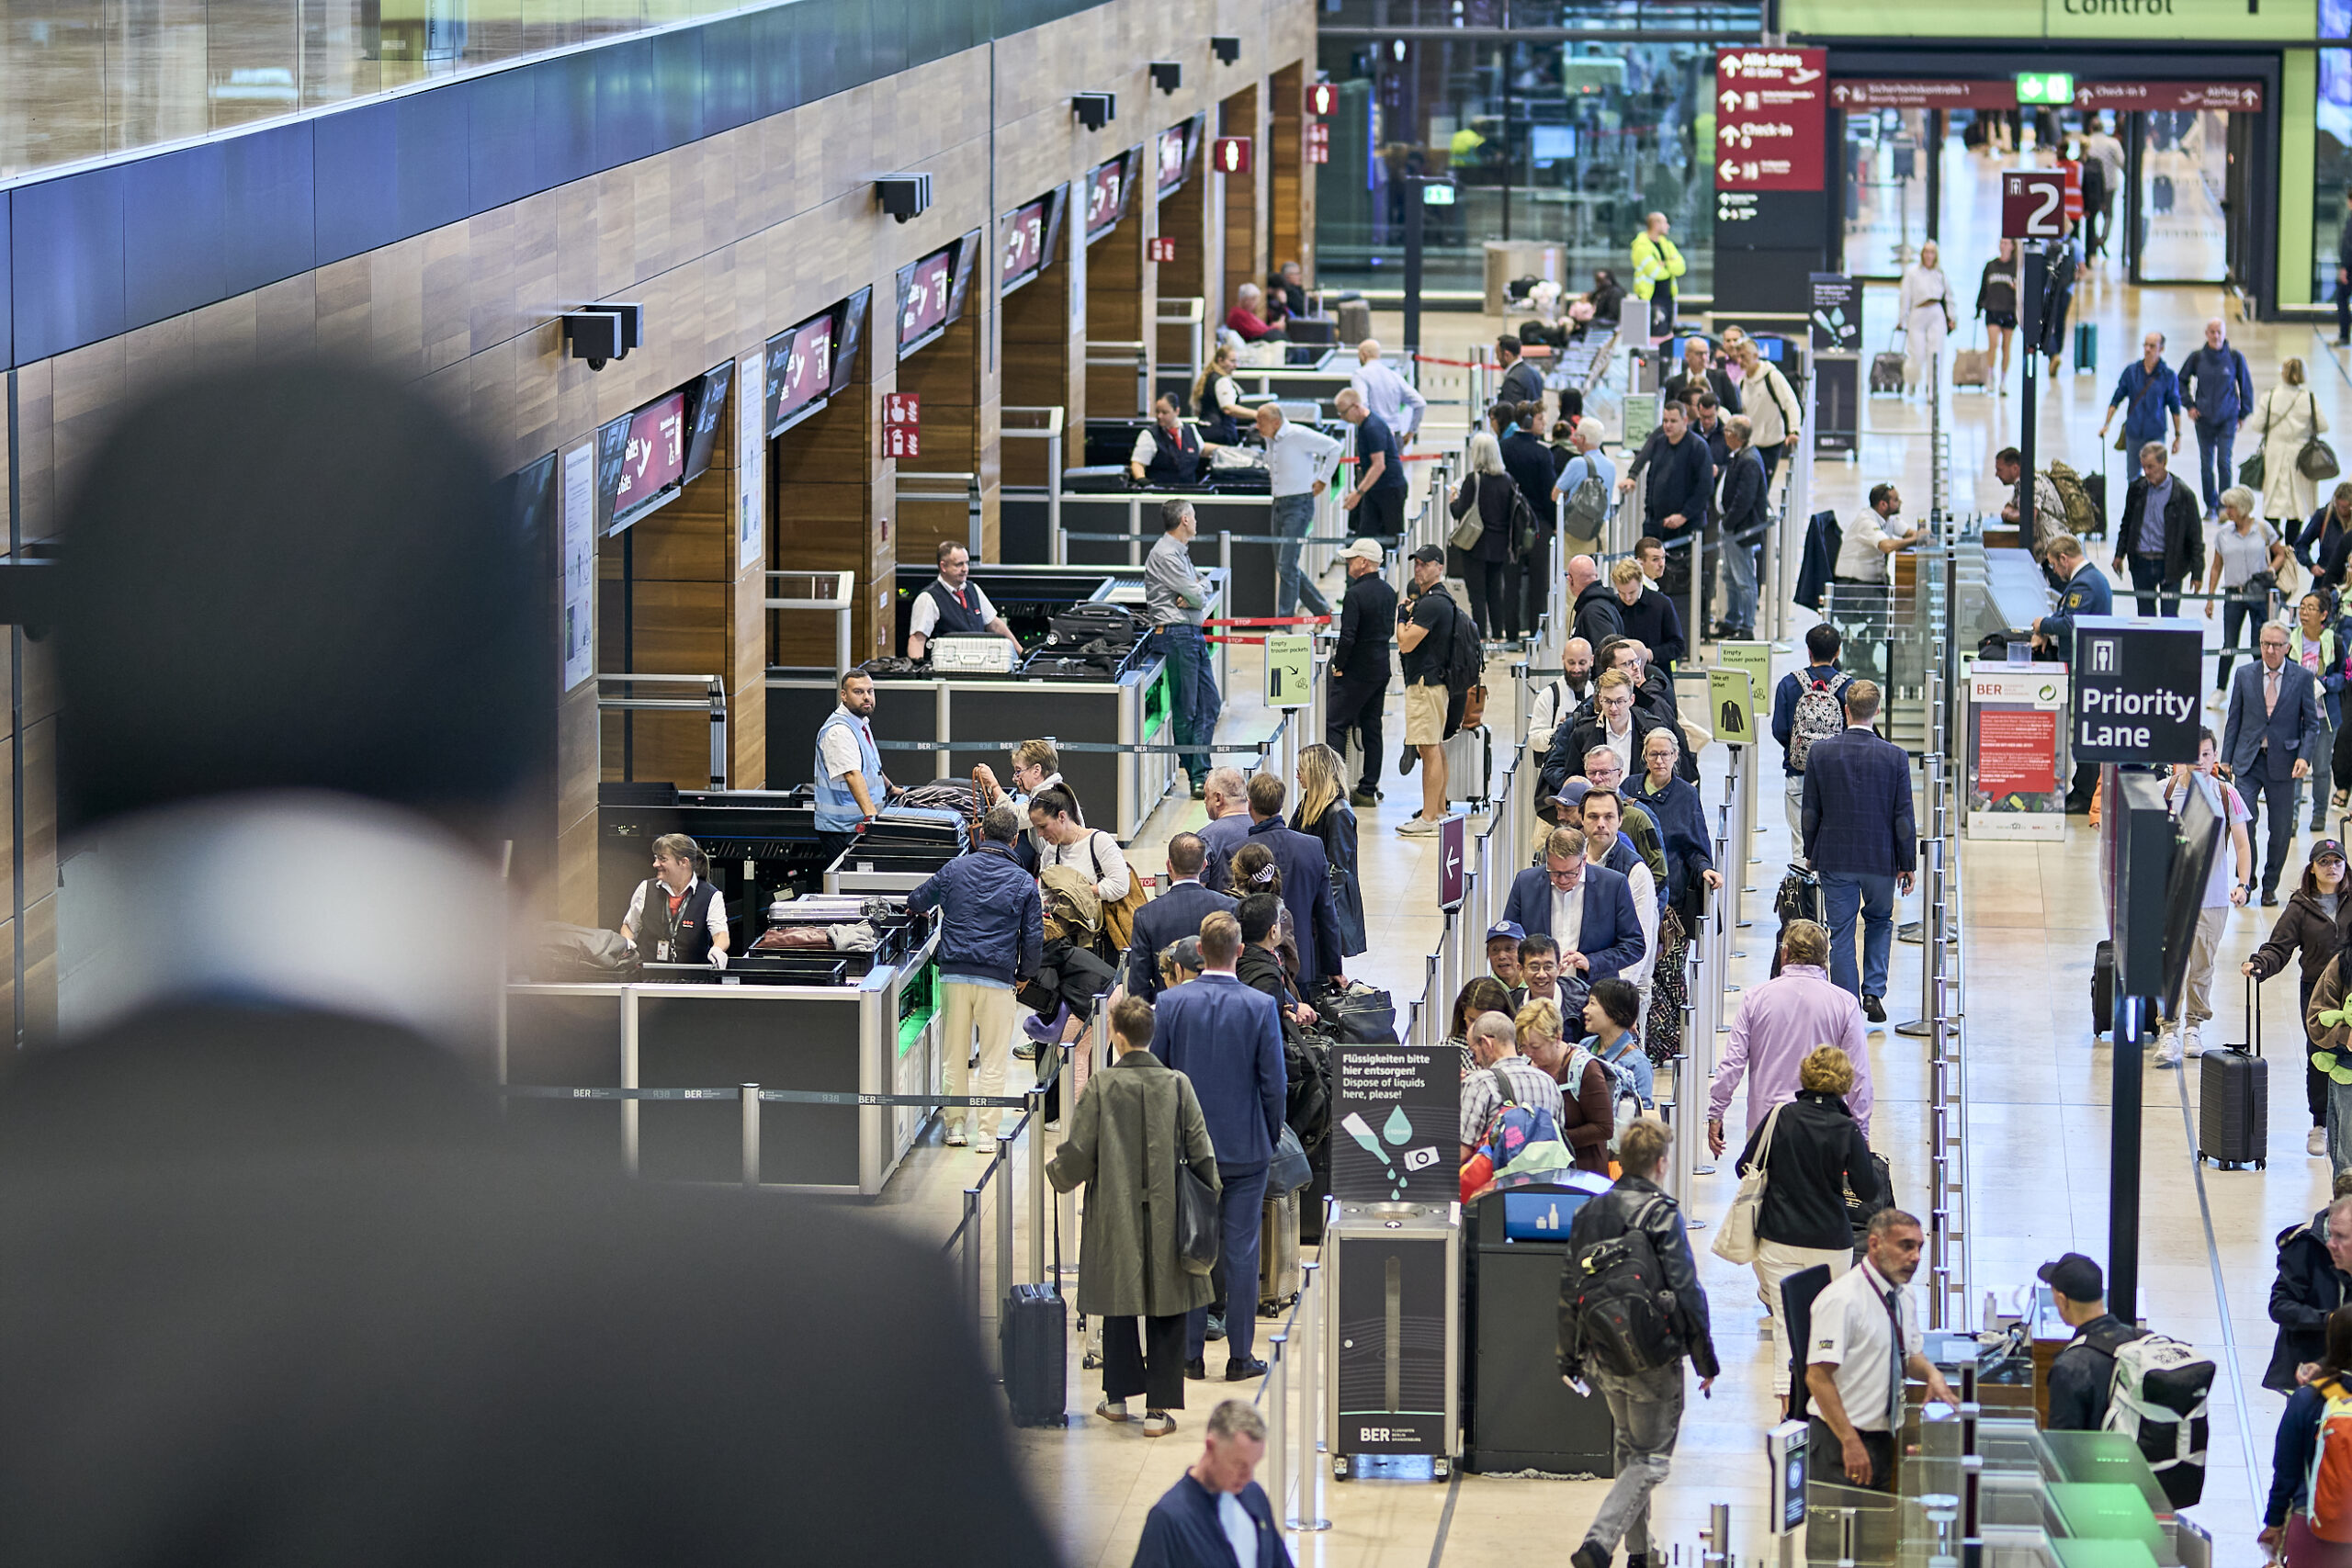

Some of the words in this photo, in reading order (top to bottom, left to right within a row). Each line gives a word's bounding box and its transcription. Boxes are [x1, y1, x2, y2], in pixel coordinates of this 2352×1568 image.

[2064, 0, 2174, 15] Control
[1742, 52, 1767, 67] Alle
[1768, 52, 1803, 68] Gates
[1741, 122, 1793, 137] Check-in
[2027, 183, 2060, 234] 2
[1976, 683, 2002, 695] BER
[2082, 687, 2195, 724] Priority
[2081, 720, 2151, 748] Lane
[1140, 878, 1156, 886] TOP
[1342, 1054, 1406, 1066] Flüssigkeiten
[1408, 1054, 1430, 1064] bitte
[1342, 1066, 1362, 1076] hier
[1363, 1066, 1416, 1077] entsorgen!
[1342, 1077, 1379, 1089] Dispose
[1381, 1077, 1391, 1087] of
[1394, 1077, 1426, 1089] liquids
[573, 1089, 591, 1098] BER
[684, 1090, 702, 1099] BER
[858, 1095, 876, 1104] BER
[1342, 1090, 1367, 1100] here,
[1369, 1090, 1402, 1100] please!
[969, 1098, 987, 1106] BER
[1360, 1427, 1390, 1442] BER
